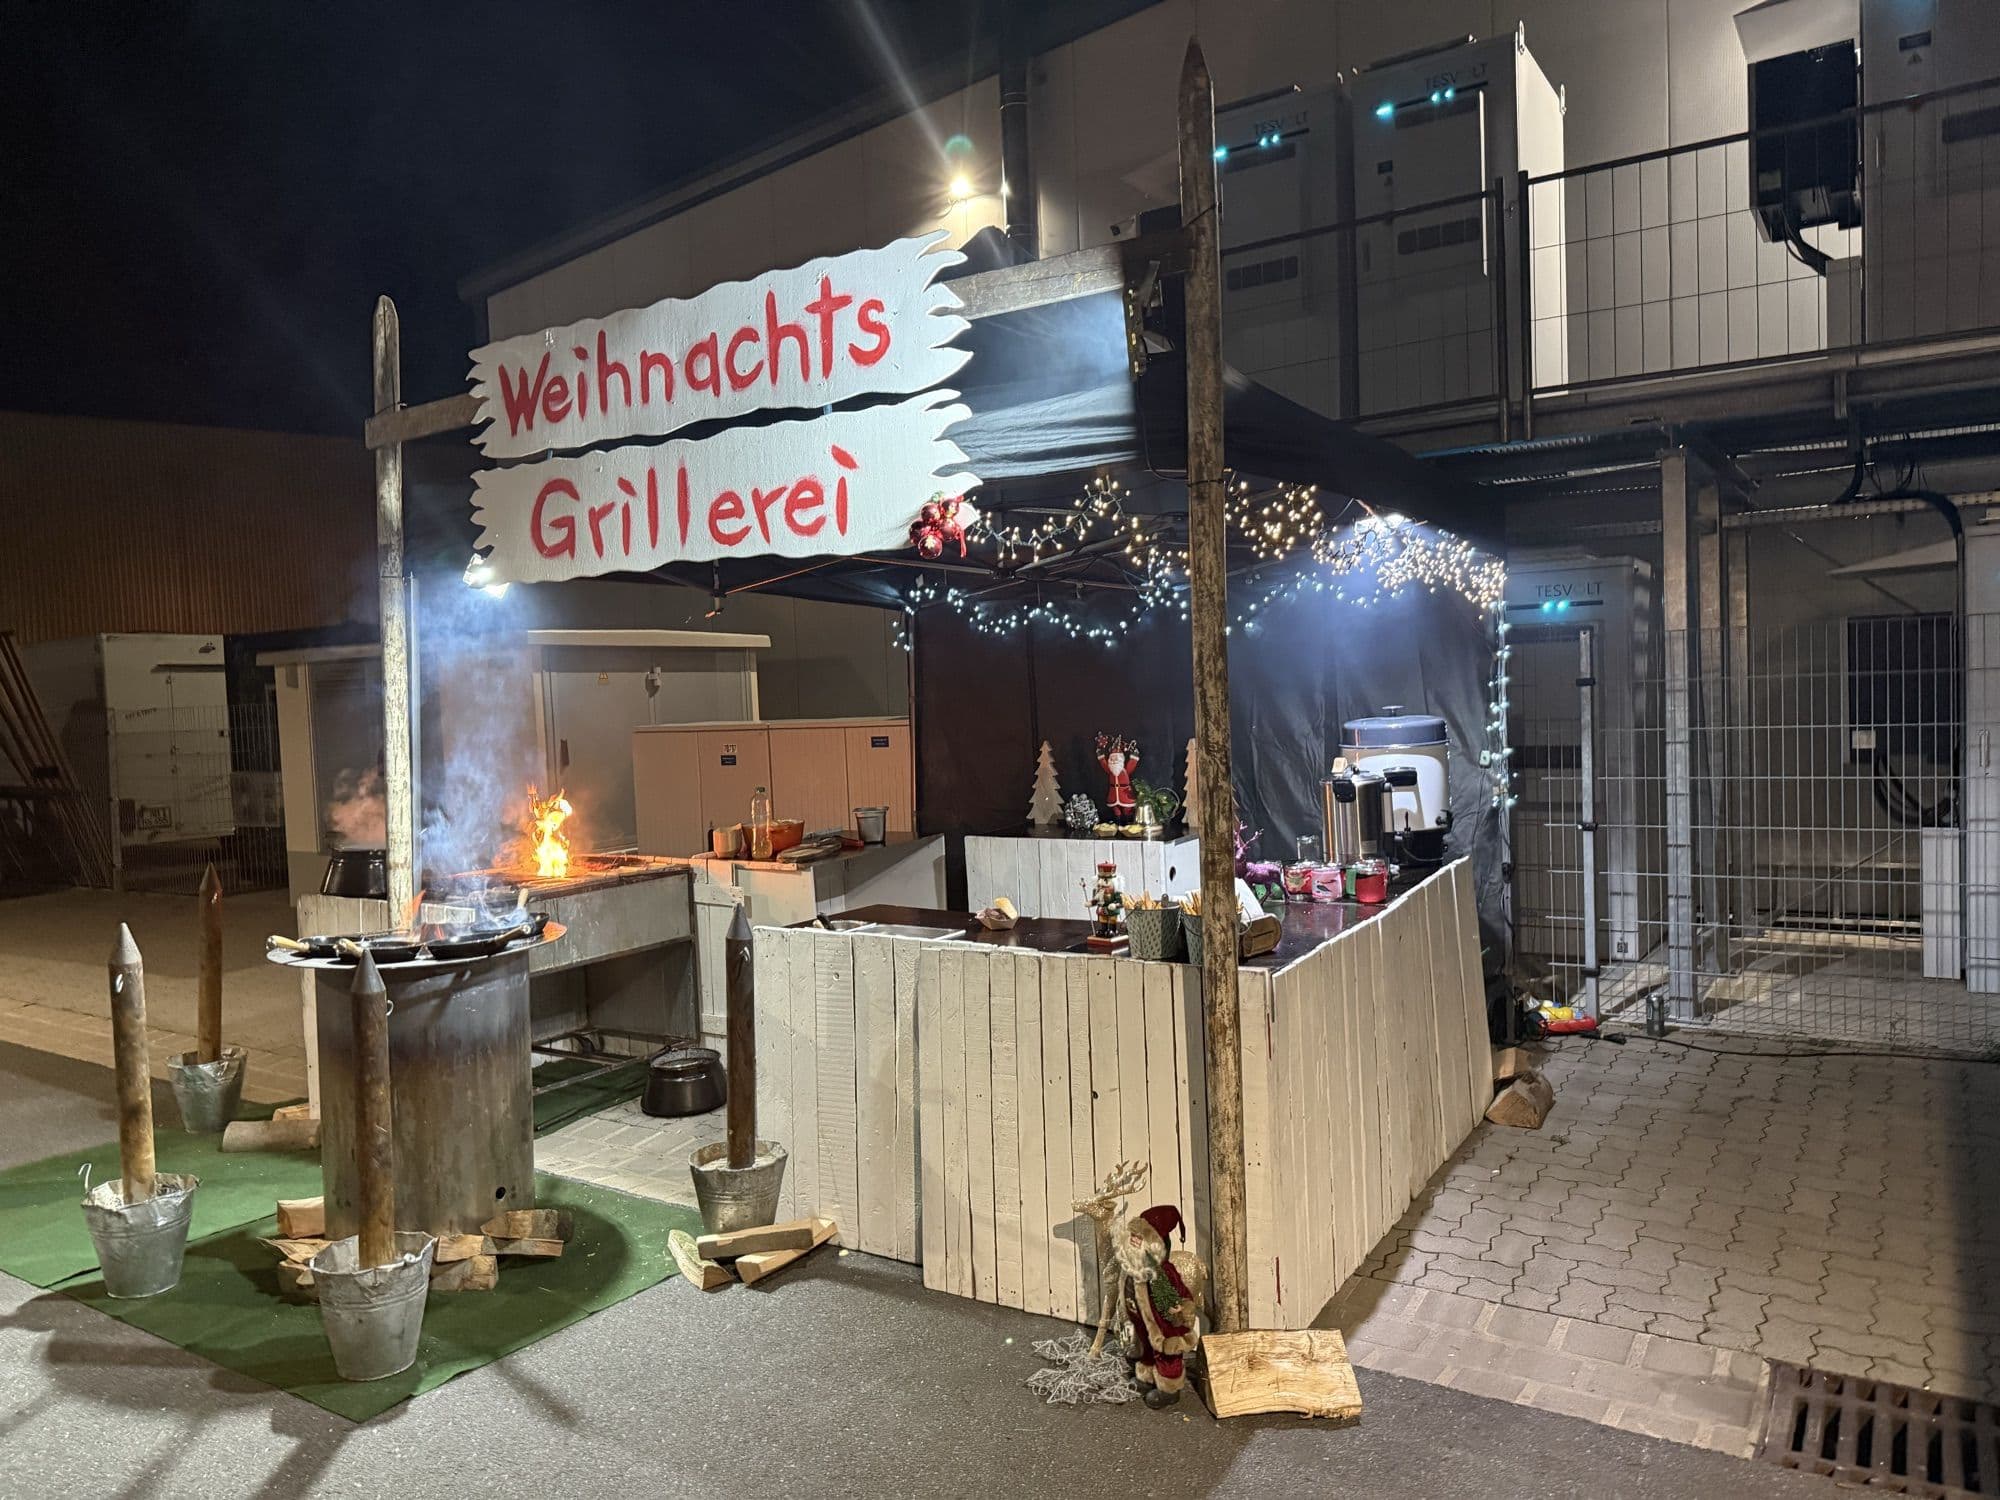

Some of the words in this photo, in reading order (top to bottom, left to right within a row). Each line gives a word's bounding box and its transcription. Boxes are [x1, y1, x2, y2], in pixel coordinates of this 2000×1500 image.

[1424, 63, 1488, 91] TESVLT
[1254, 110, 1309, 135] TESVLT
[498, 276, 891, 437] Weihnachts
[531, 444, 860, 560] Grillerei
